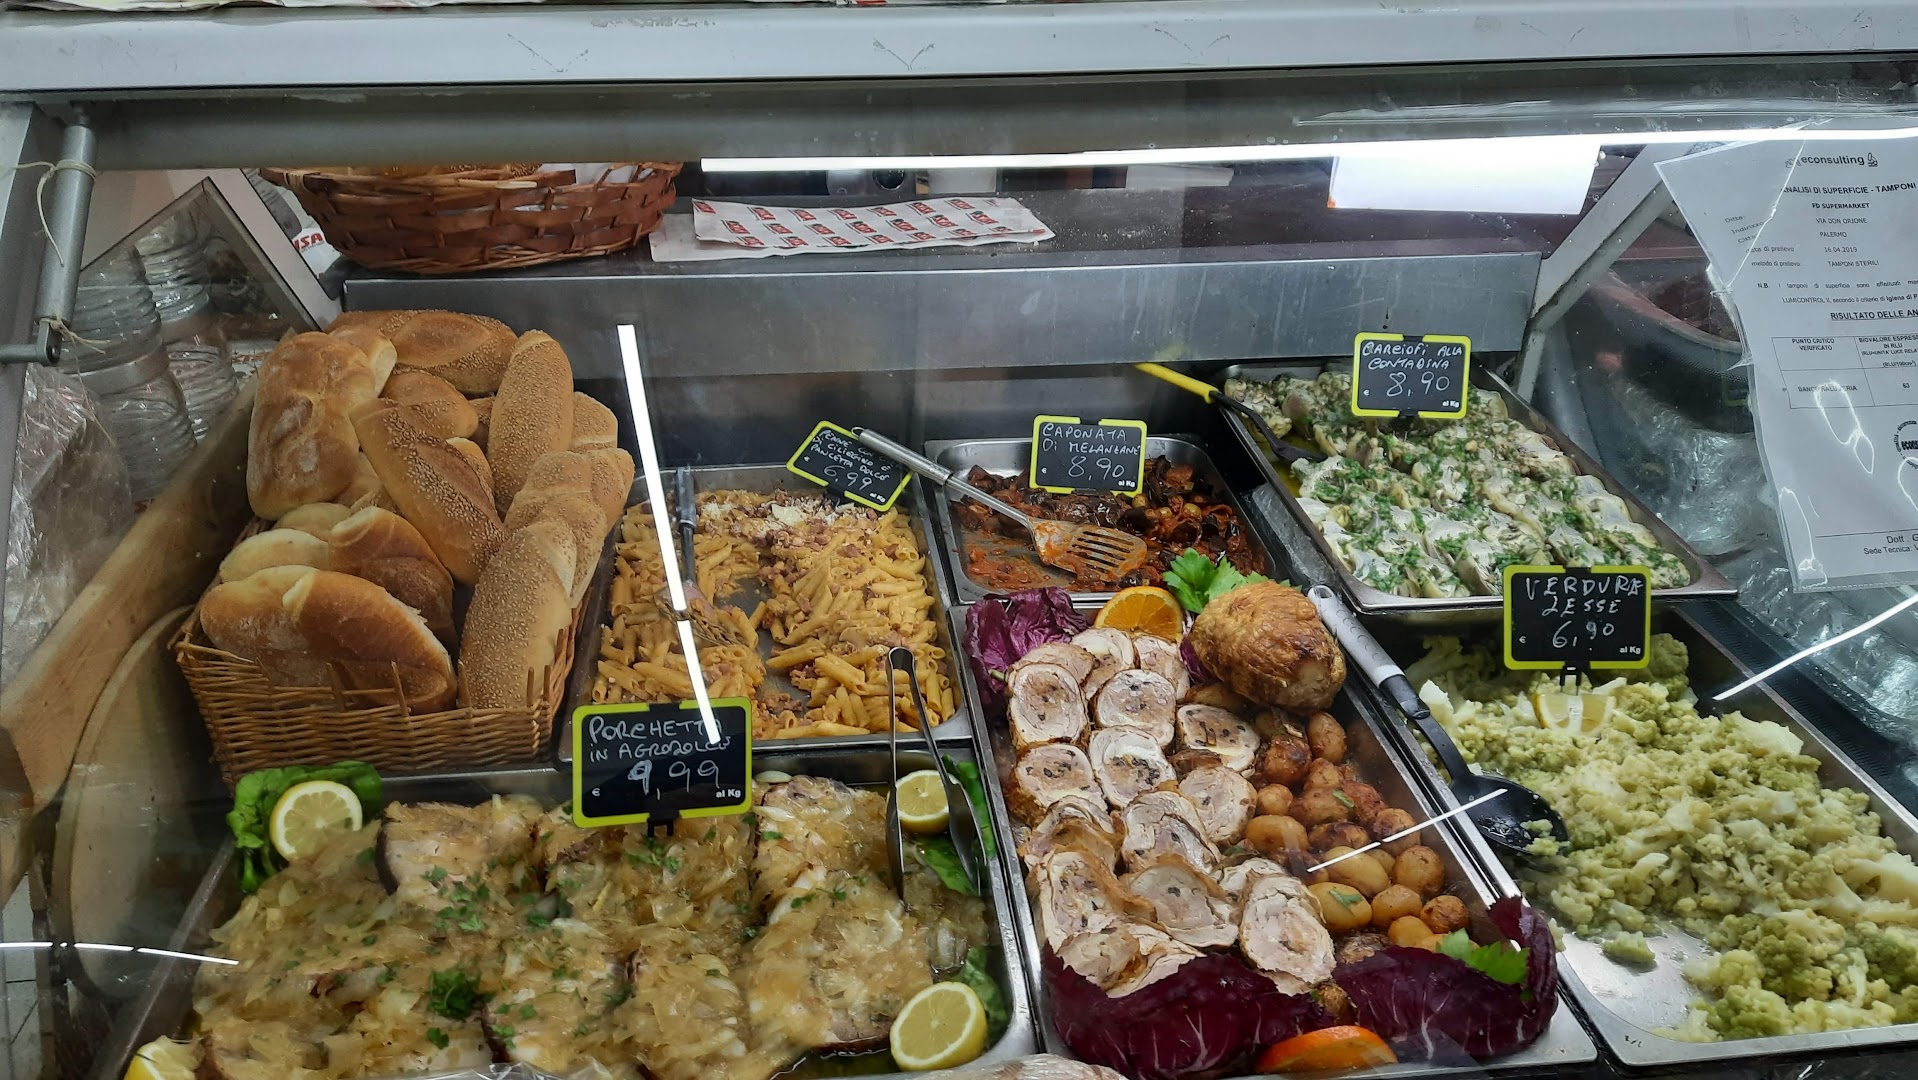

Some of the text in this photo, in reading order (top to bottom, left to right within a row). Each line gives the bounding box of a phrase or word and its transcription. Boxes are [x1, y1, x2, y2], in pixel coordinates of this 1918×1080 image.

[1800, 155, 1865, 166] econsulting
[1813, 186, 1821, 194] DI
[1822, 186, 1869, 194] SUPERFICIE
[1875, 182, 1917, 193] TAMPONI
[1830, 311, 1875, 320] RISULTATO
[1877, 310, 1904, 318] DELLE
[1437, 345, 1462, 357] ALLA
[1368, 357, 1449, 370] CONTADINA
[1386, 371, 1450, 397] 8,90
[1450, 400, 1459, 408] Kg
[1042, 422, 1126, 441] CAPONATA
[1068, 455, 1125, 481] 8,90
[1126, 480, 1136, 488] Kg
[1863, 547, 1882, 555] Sede
[1883, 545, 1913, 554] Tecnica:
[1518, 620, 1615, 648] € 6,90
[1629, 646, 1641, 655] Kg
[591, 759, 721, 801] € 9,99
[715, 788, 742, 799] al Kg
